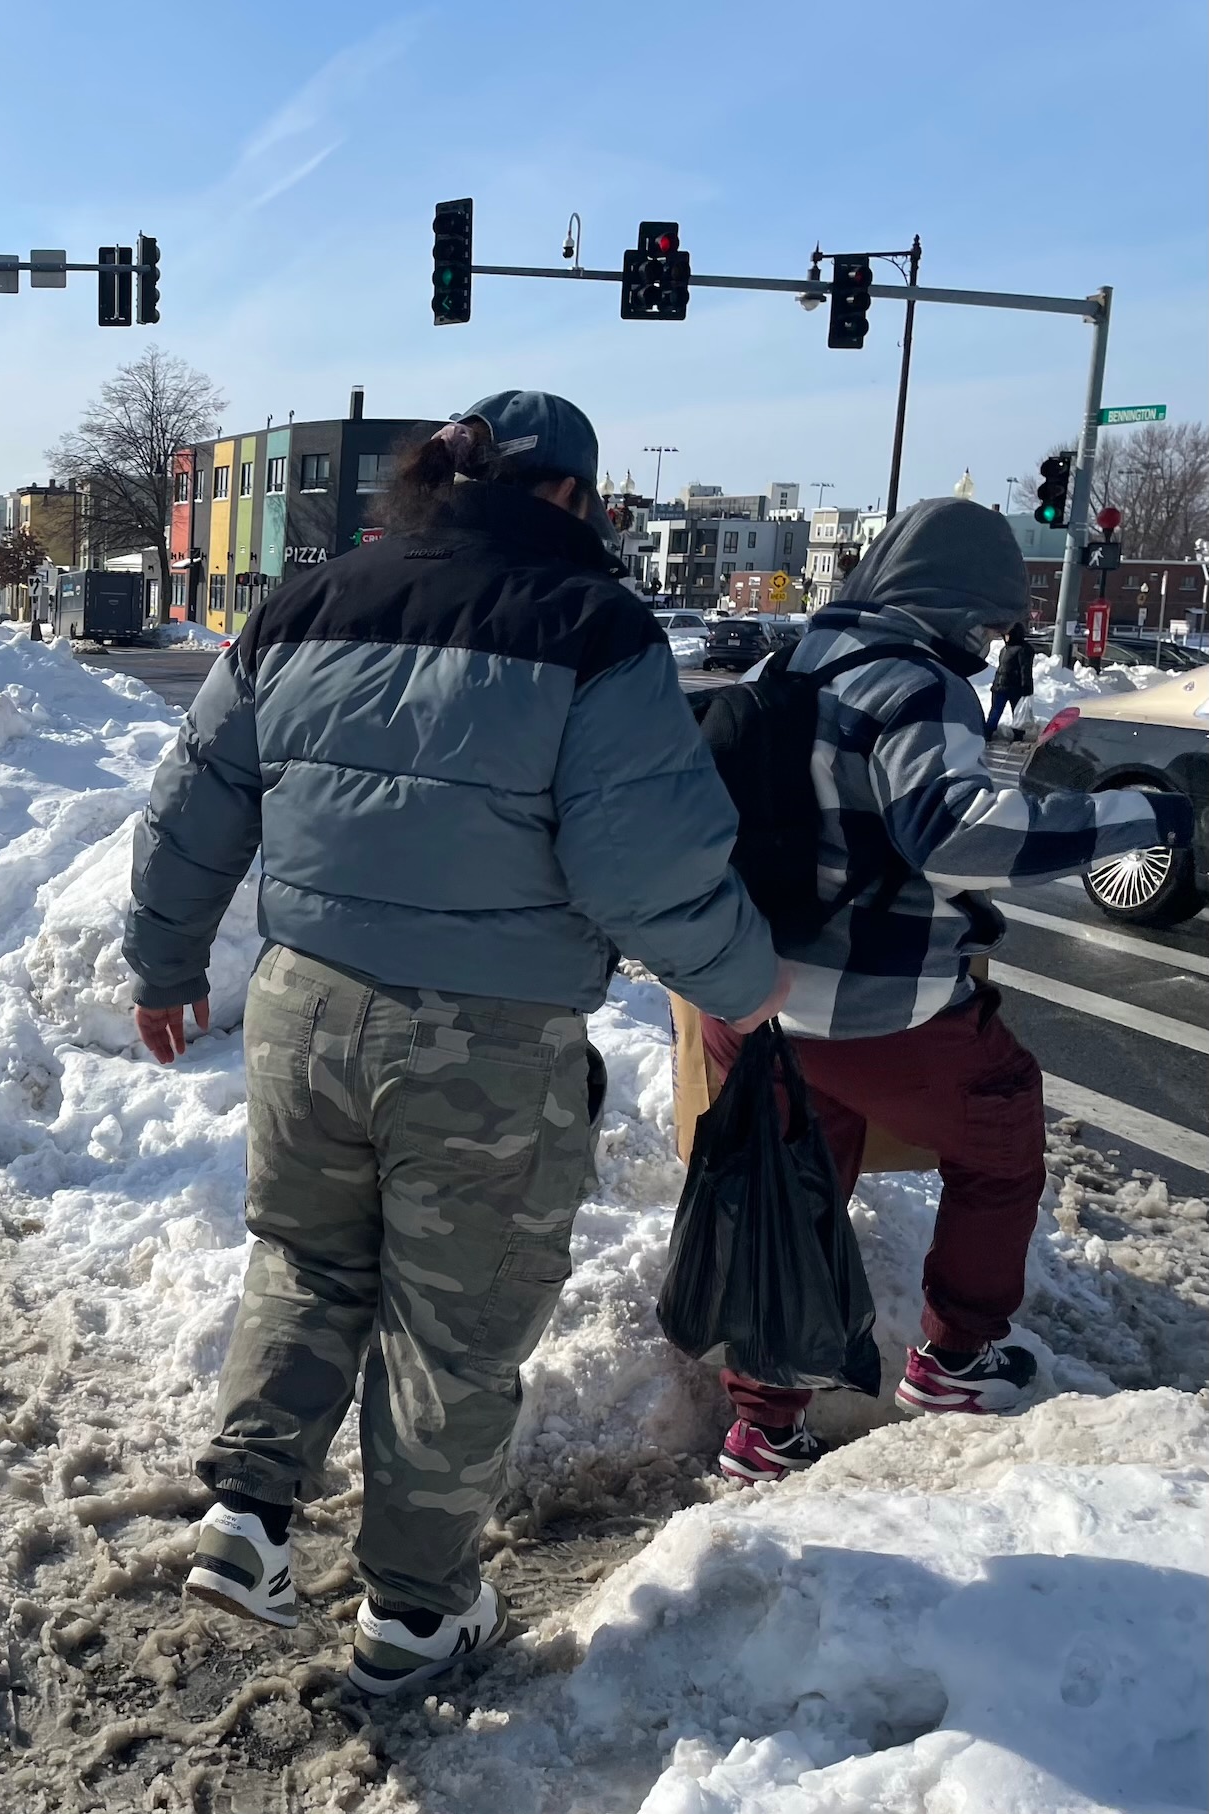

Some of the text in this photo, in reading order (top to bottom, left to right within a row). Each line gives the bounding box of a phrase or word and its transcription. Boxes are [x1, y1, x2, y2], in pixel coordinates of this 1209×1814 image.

[1108, 408, 1157, 422] BENNINGTON
[284, 546, 327, 563] PIZZA
[215, 1518, 241, 1530] balance
[223, 1514, 237, 1522] new
[361, 1619, 382, 1637] balance
[450, 1625, 480, 1657] N
